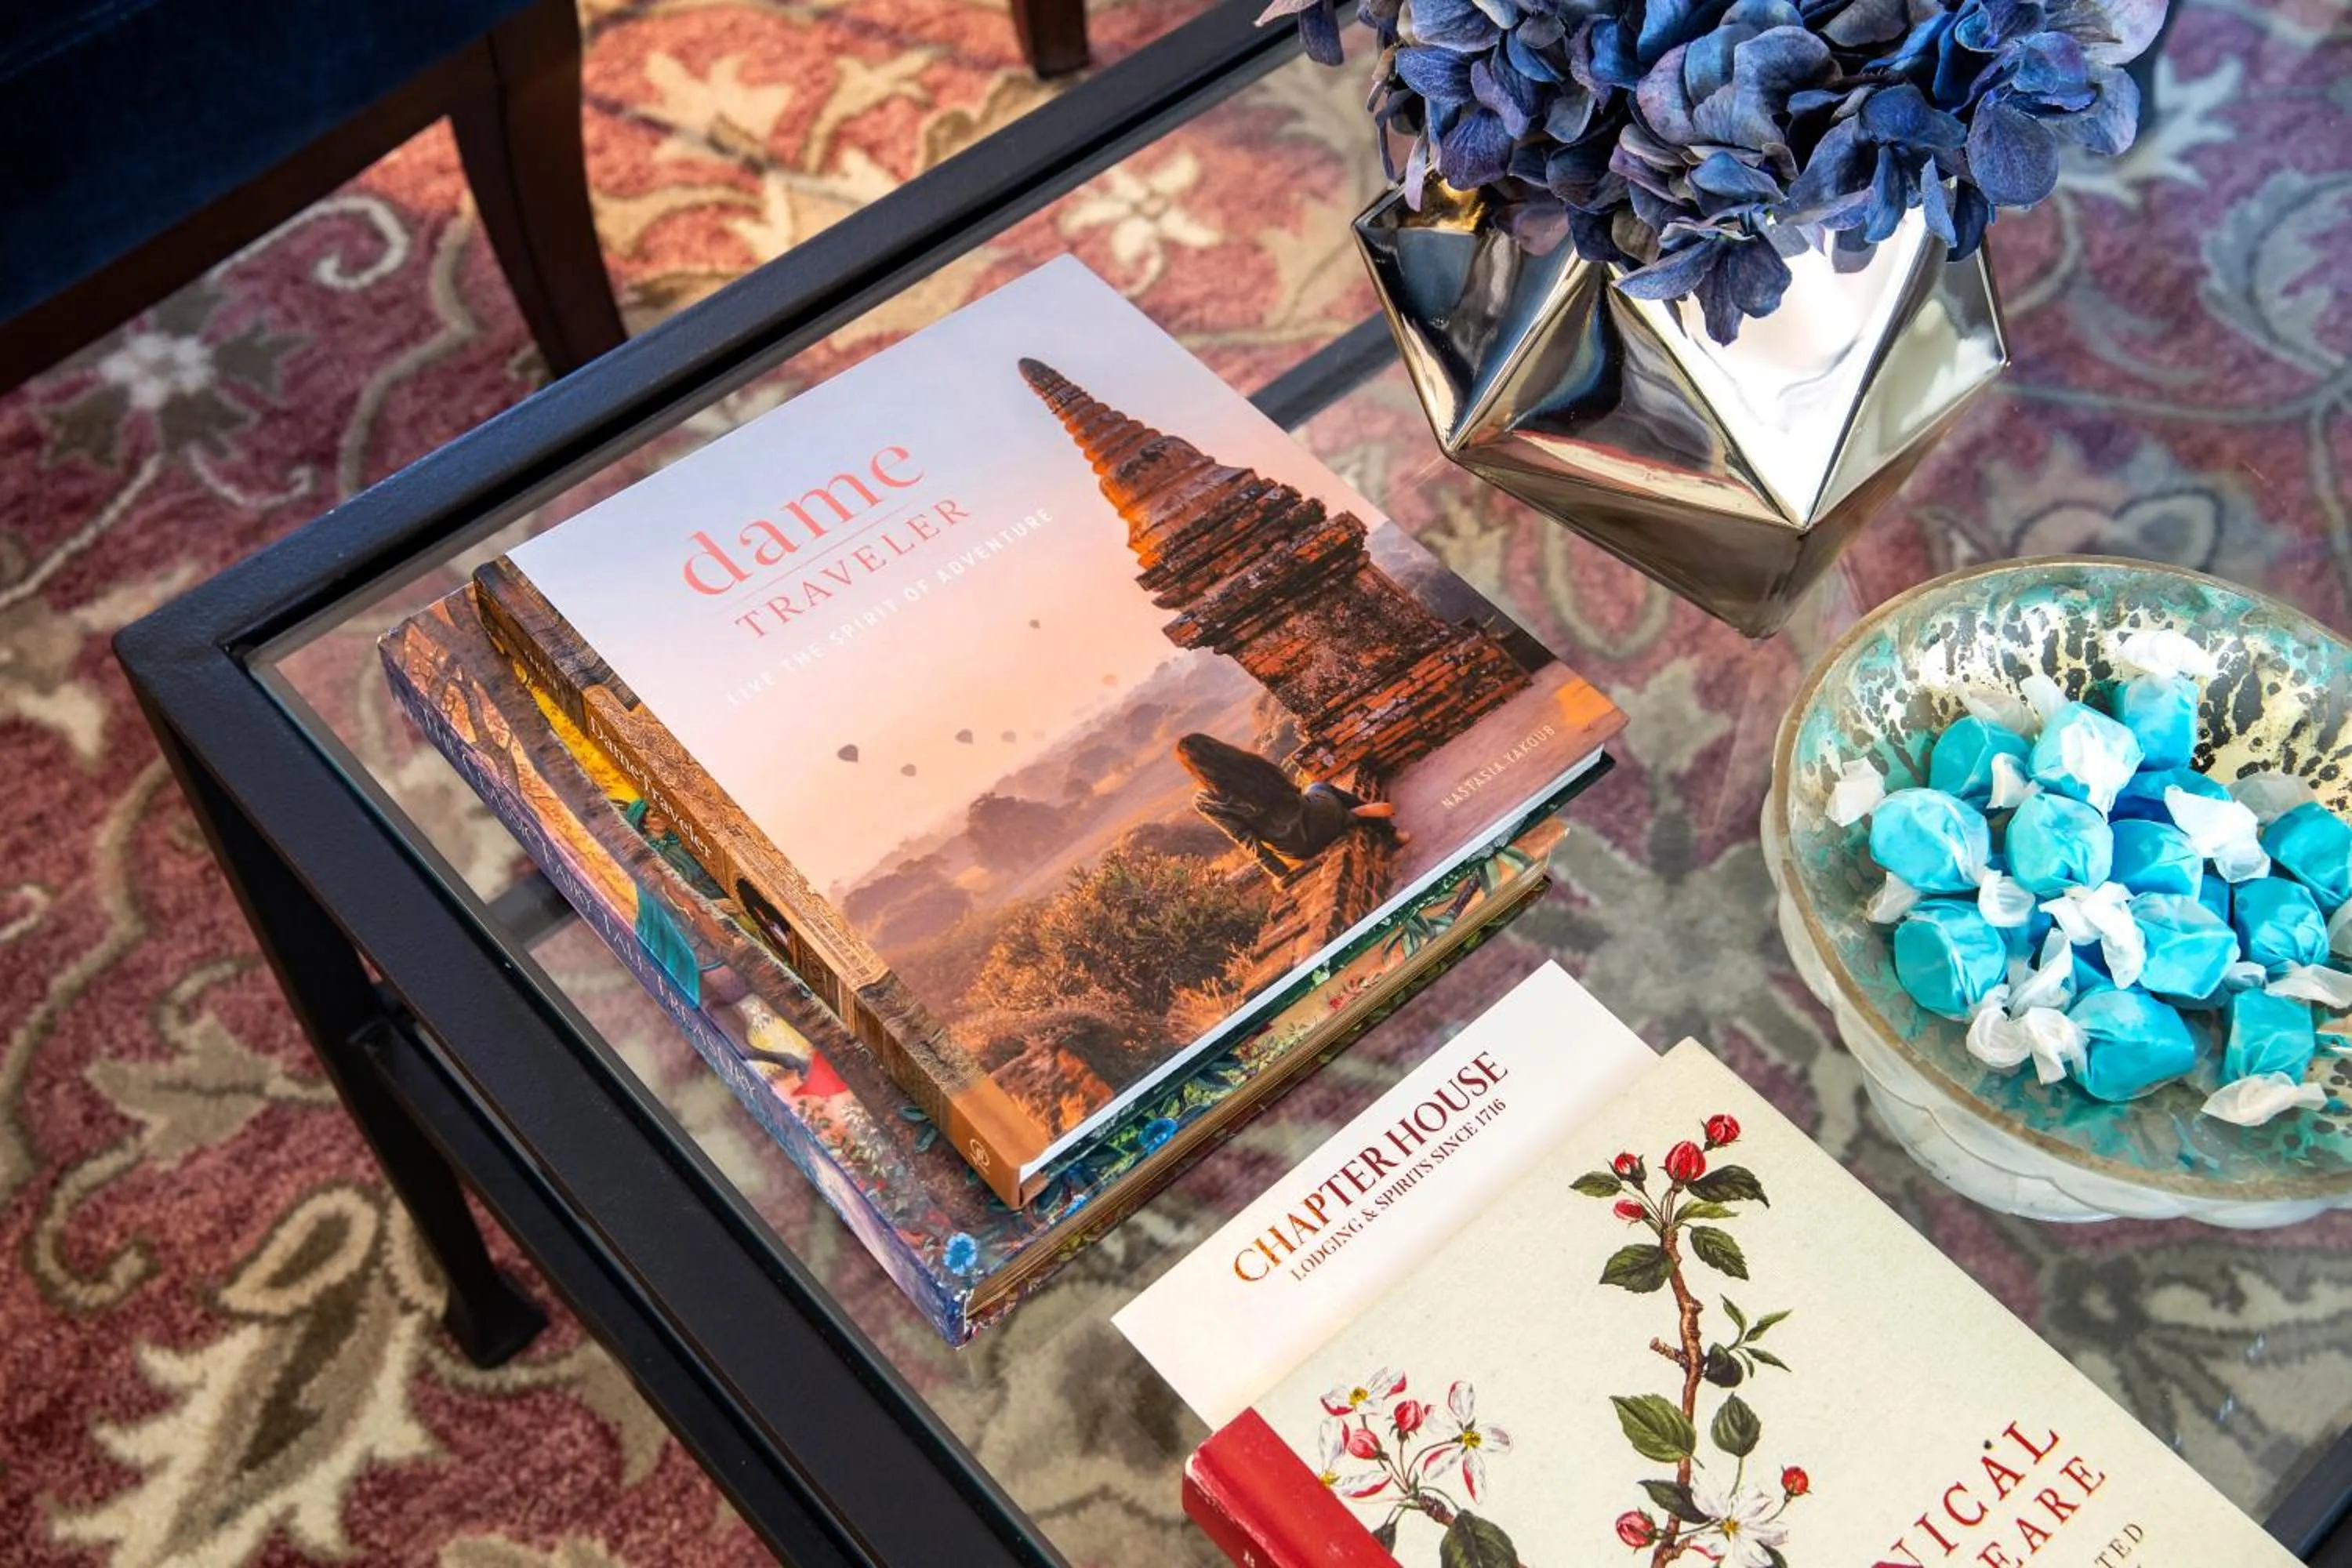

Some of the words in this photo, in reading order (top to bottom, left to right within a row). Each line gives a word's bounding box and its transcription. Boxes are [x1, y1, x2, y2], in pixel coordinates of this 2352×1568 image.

[684, 445, 924, 596] dame
[735, 498, 970, 639] TRAVELER
[726, 672, 776, 707] LIVE
[784, 642, 826, 675] THE
[829, 600, 900, 645] SPIRIT
[904, 578, 930, 602] OF
[936, 506, 1054, 585] ADVENTURE
[1440, 760, 1508, 810] NASTASIA
[1503, 724, 1556, 764] YAKOUB
[1232, 1145, 1399, 1283] CHAPTER
[1385, 1051, 1508, 1157] HOUSE
[1289, 1218, 1363, 1283] LODGING
[1362, 1205, 1378, 1223] &
[1376, 1158, 1434, 1211] SPIRITS
[1430, 1121, 1479, 1166] SINCE
[1474, 1098, 1507, 1130] 1716
